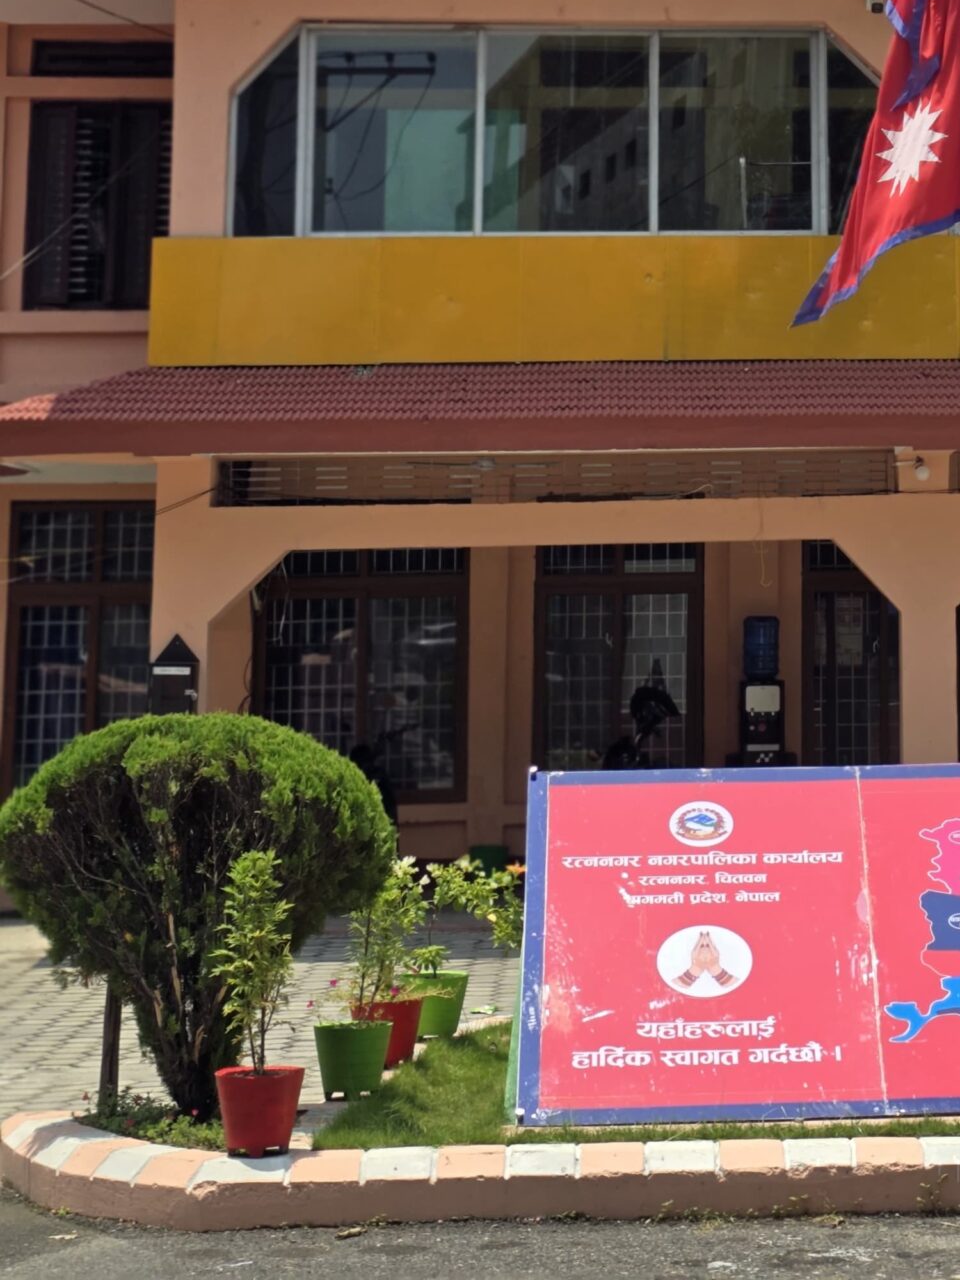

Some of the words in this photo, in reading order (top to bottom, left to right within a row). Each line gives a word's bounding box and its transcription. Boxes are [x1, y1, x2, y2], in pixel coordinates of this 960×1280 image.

[562, 855, 641, 868] रत्ननगर
[648, 851, 757, 867] नगरपालिका
[763, 849, 844, 865] कार्यालय
[715, 871, 768, 885] चितवन
[735, 889, 781, 903] नेपाल
[571, 1046, 653, 1069] हार्दिक
[660, 1048, 741, 1067] स्वागत
